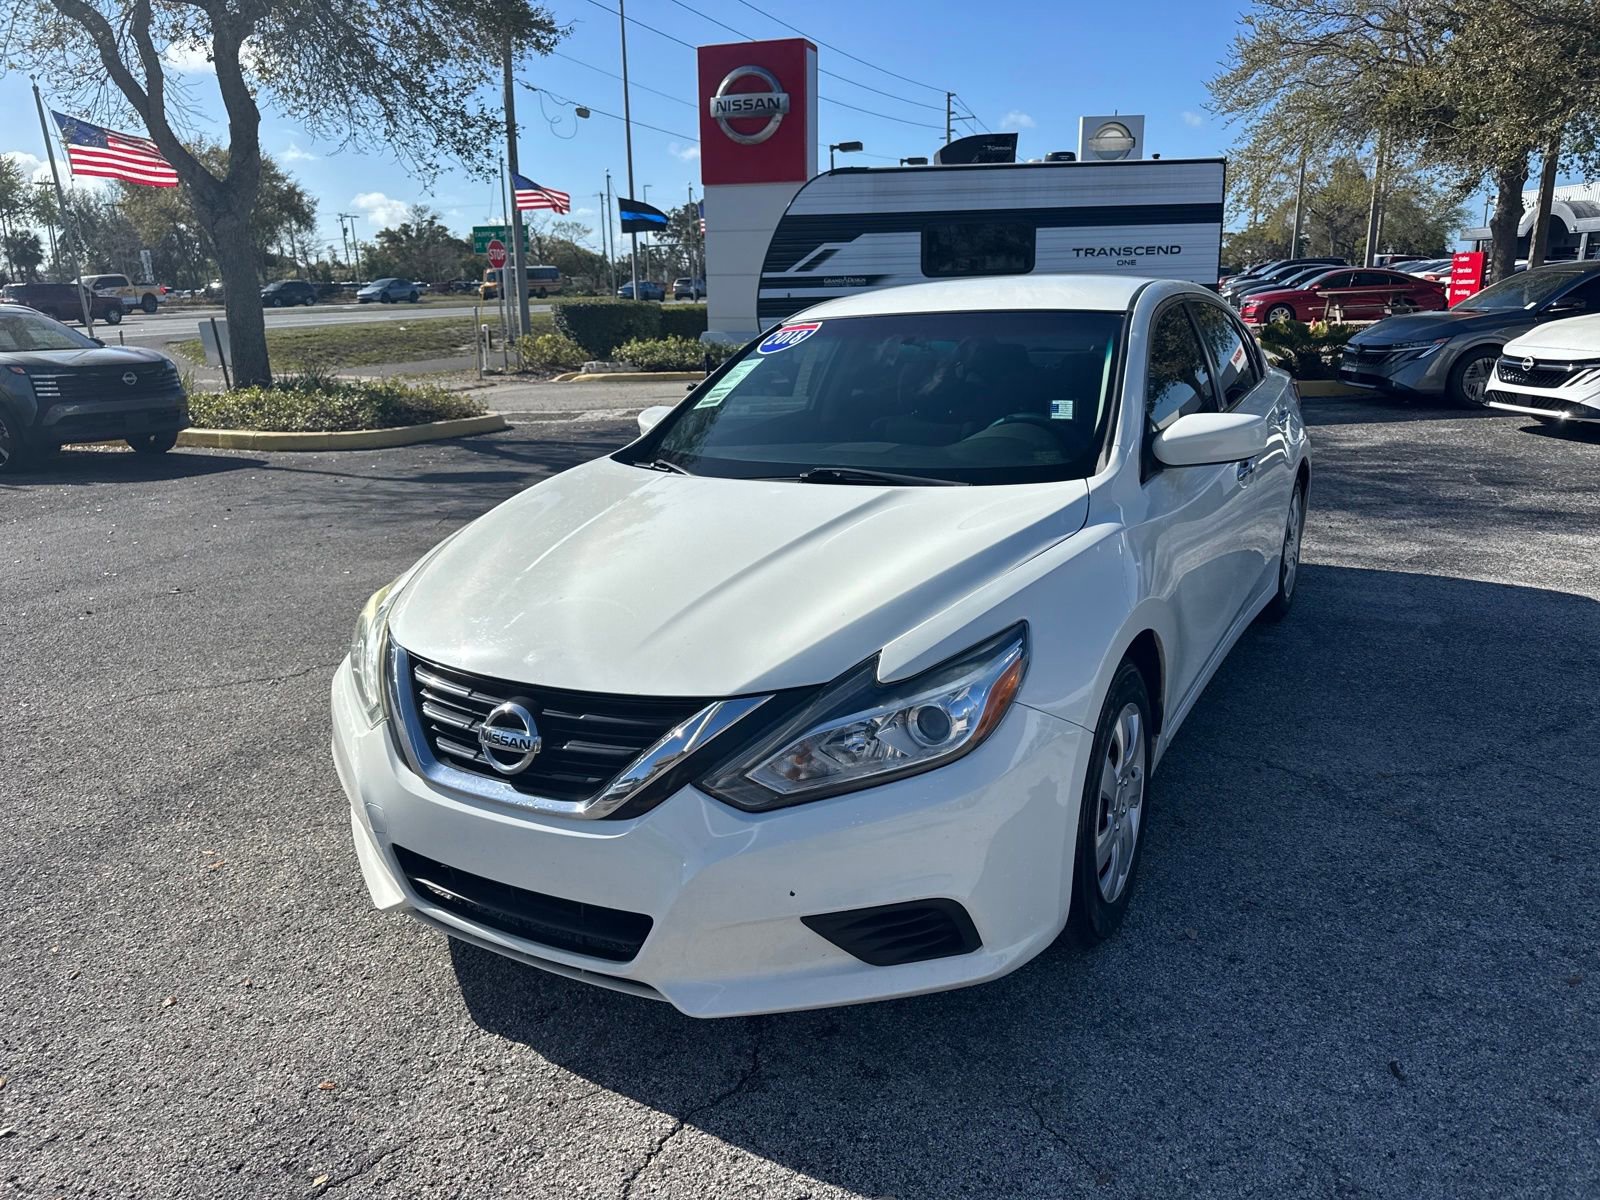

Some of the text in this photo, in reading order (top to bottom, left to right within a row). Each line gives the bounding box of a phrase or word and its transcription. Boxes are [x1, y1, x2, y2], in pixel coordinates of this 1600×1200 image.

[716, 97, 780, 112] NISSAN
[489, 249, 505, 260] STOP
[1072, 245, 1182, 257] TRANSCEND
[764, 330, 806, 346] 2018
[480, 729, 532, 750] NISSAN
